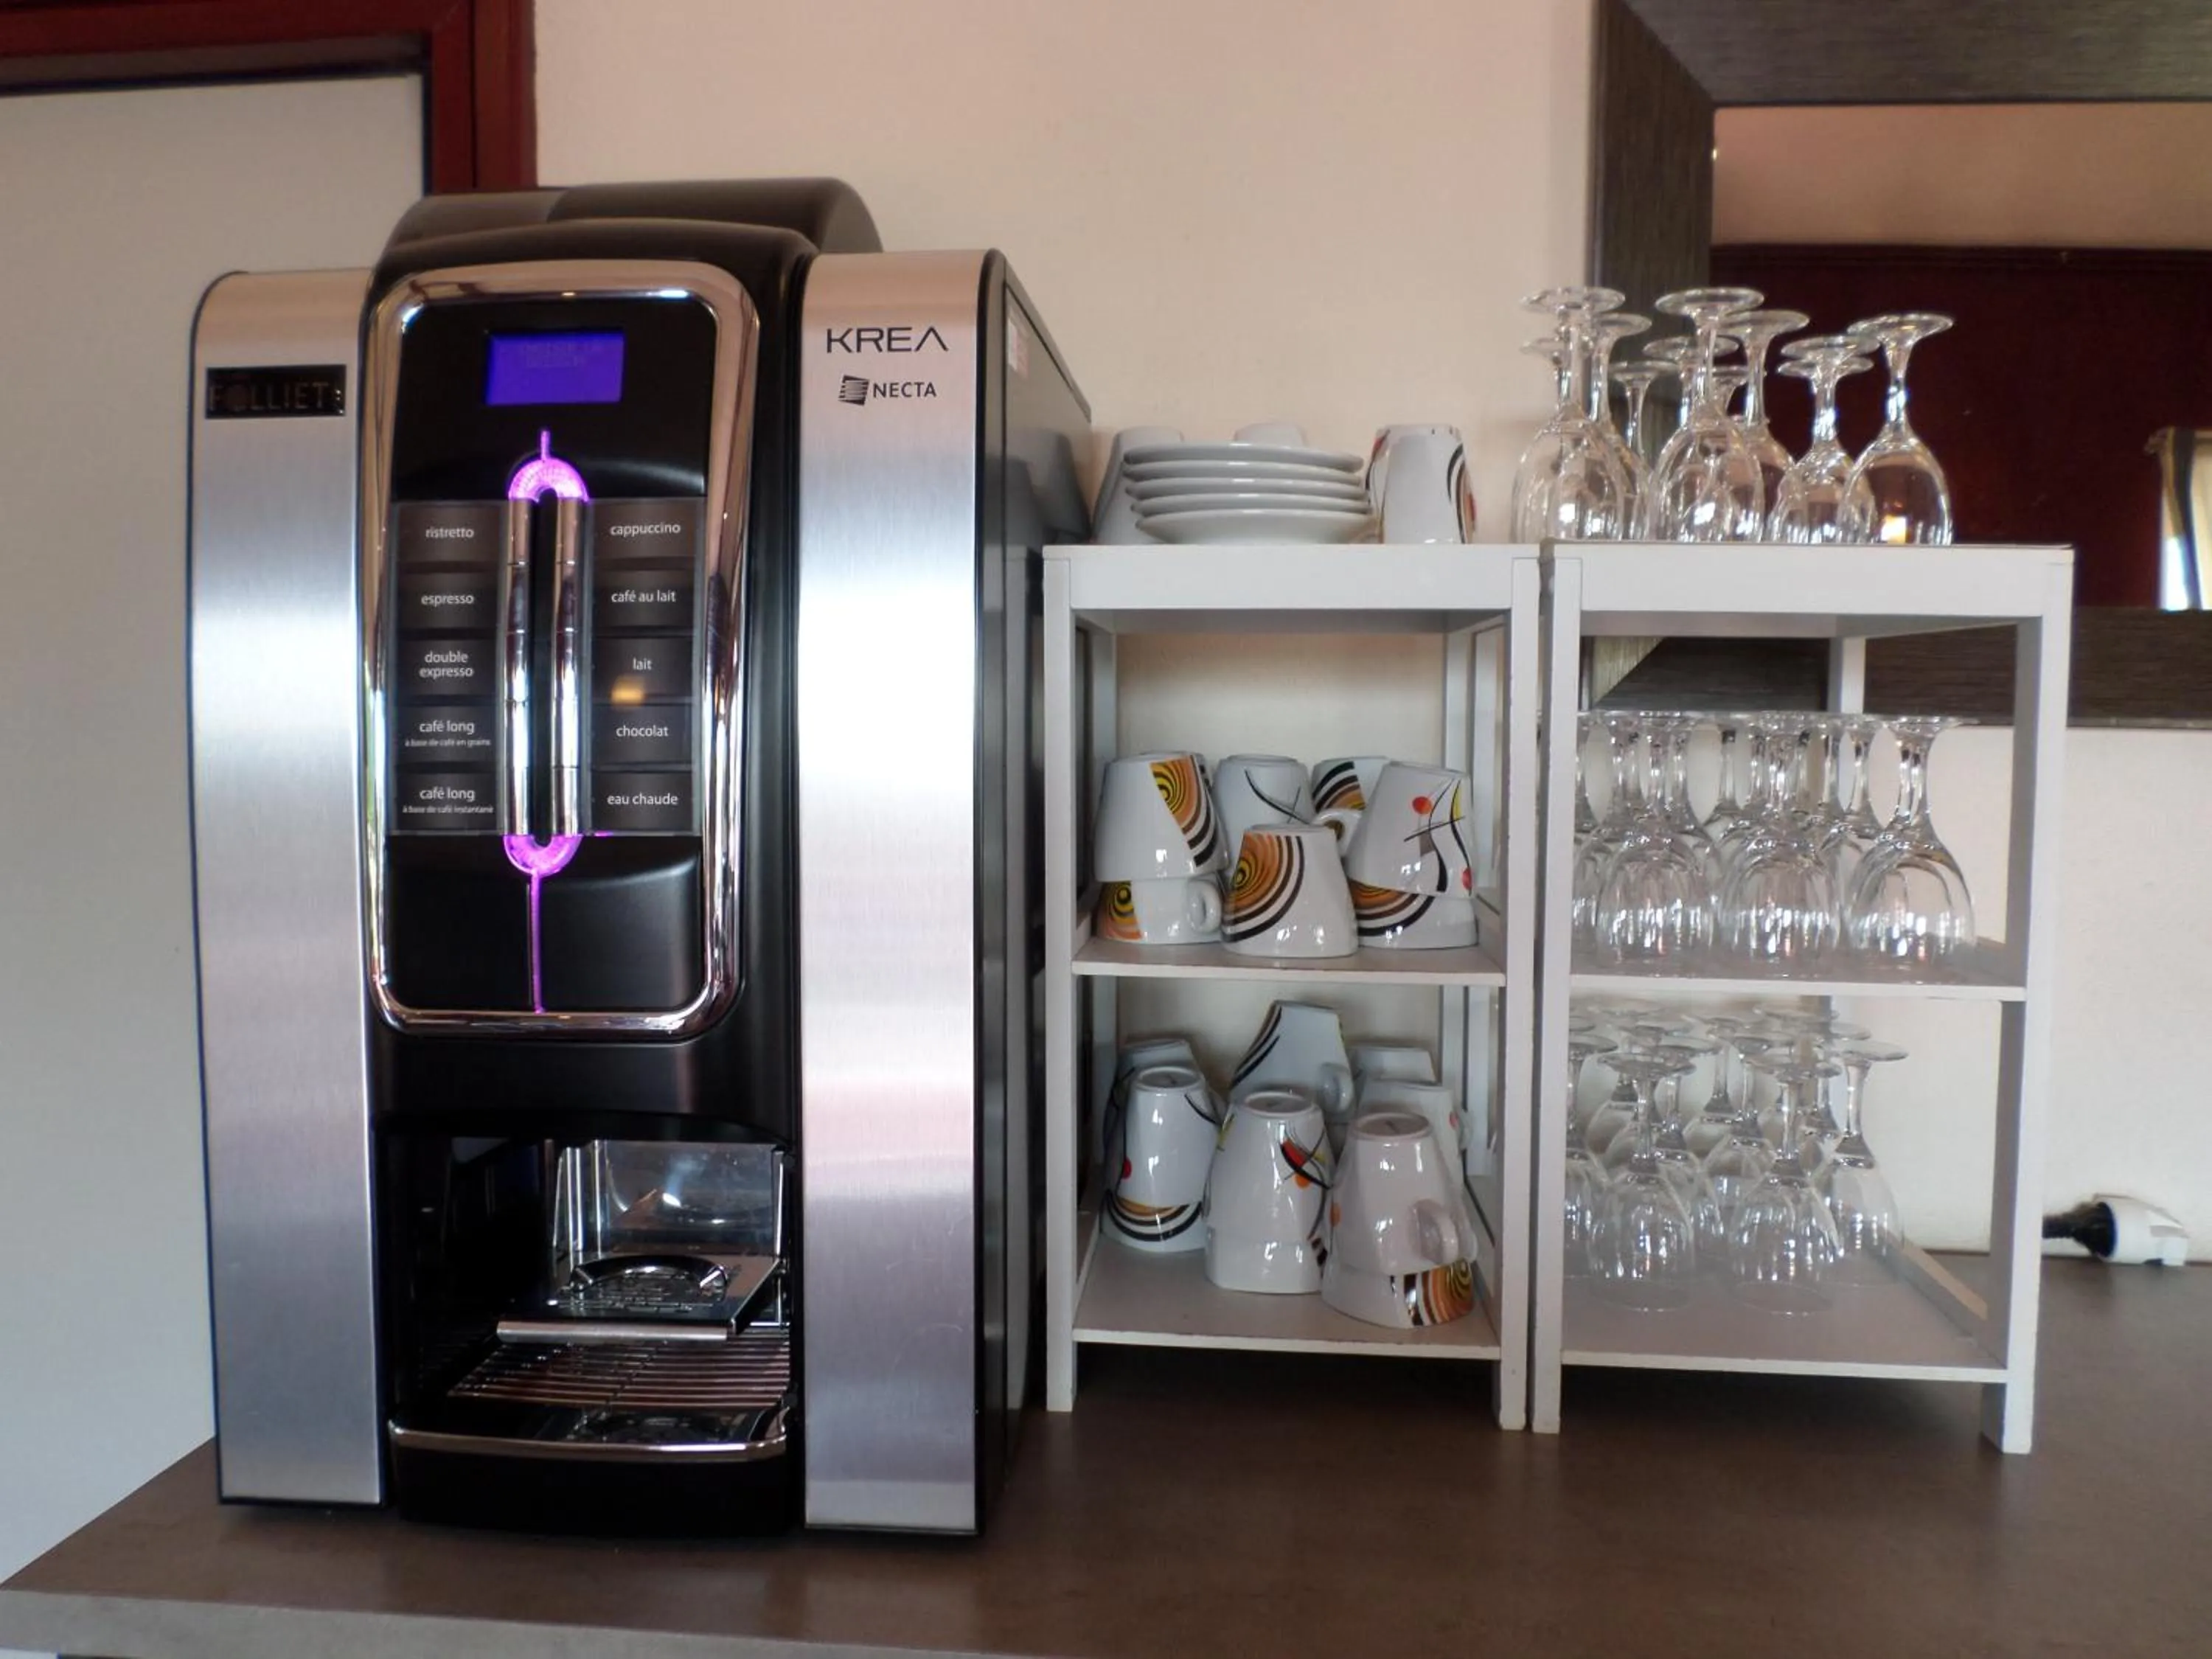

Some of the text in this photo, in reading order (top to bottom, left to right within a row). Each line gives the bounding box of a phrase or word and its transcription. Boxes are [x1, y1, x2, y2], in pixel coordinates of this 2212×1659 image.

[873, 381, 937, 398] NECTA
[425, 526, 475, 539] ristretto
[610, 522, 681, 538] cappuccino
[421, 593, 475, 606] espresso
[611, 589, 677, 603] café au lait
[424, 650, 469, 664] double
[633, 658, 653, 671] lait
[419, 666, 475, 680] expresso
[419, 720, 476, 735] café long
[615, 725, 669, 737] chocolat
[419, 786, 476, 802] café long
[607, 792, 679, 805] eau chaude
